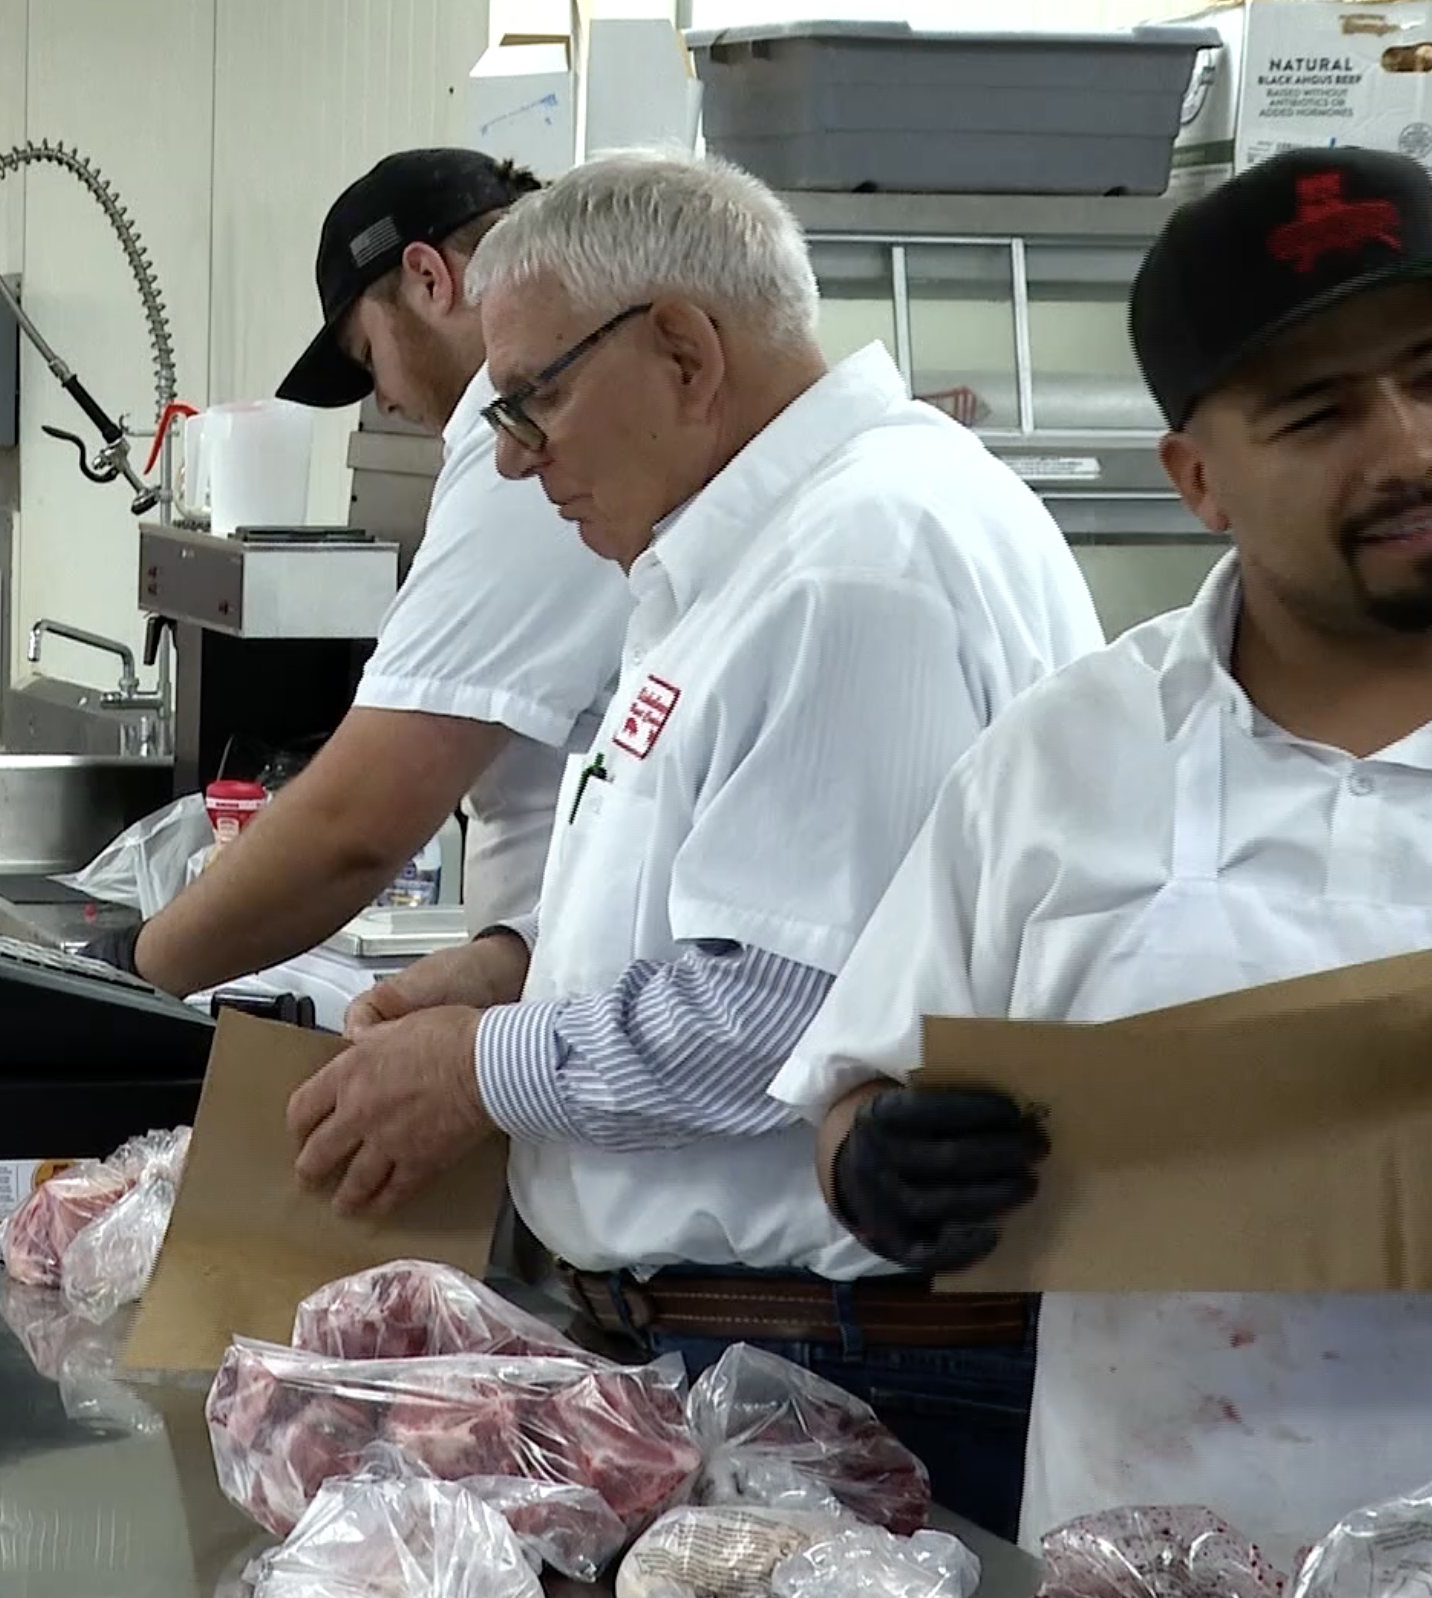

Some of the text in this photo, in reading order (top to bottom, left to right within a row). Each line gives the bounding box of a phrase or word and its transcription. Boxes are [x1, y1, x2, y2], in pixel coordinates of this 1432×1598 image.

[1269, 57, 1353, 72] NATURAL
[1257, 74, 1362, 85] BLACK ANGUS BEEF
[1266, 88, 1348, 97] RAISED WITHOUT
[1269, 98, 1329, 107] ANTIBIOTICS
[1259, 108, 1354, 117] ADDED HORMONES
